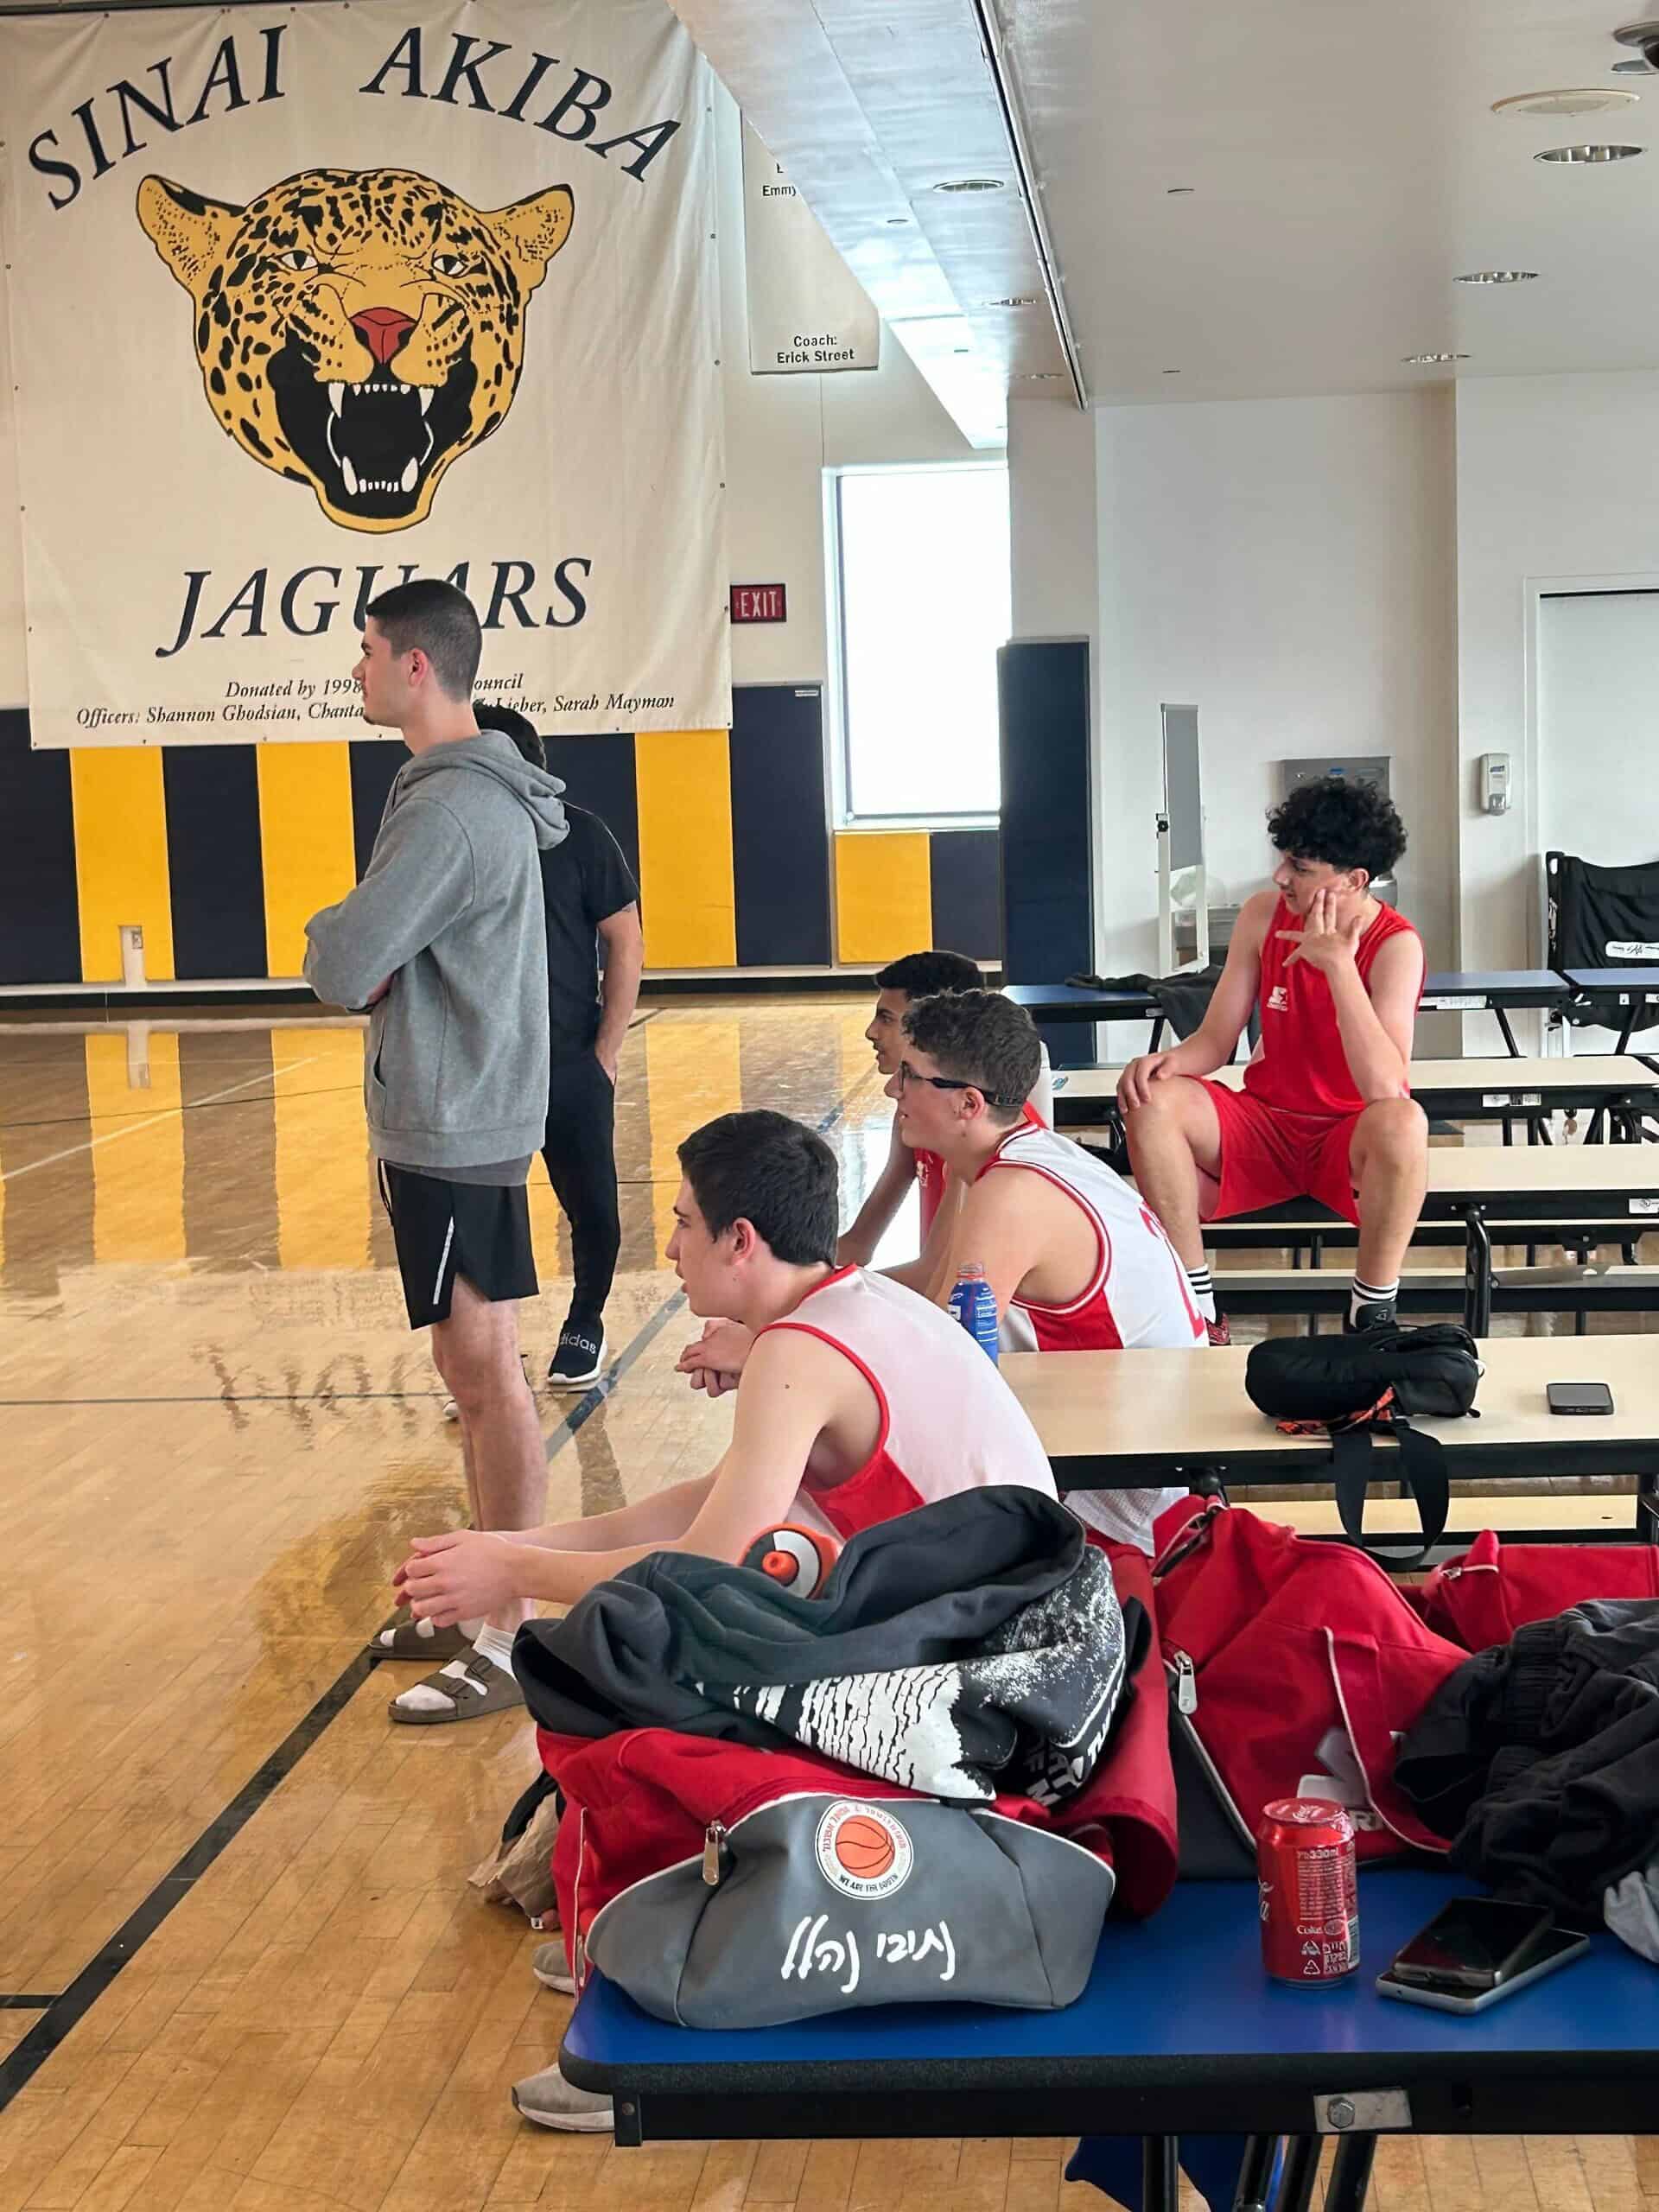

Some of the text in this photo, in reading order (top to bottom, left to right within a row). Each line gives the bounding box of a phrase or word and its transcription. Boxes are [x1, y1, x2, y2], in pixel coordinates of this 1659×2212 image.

[28, 24, 682, 211] SINAI AKIBA
[793, 334, 837, 347] Coach:
[777, 348, 855, 364] Erick Street
[741, 591, 777, 617] EXIT
[225, 672, 524, 700] Donated by 1998 ouncil
[76, 708, 140, 729] Officers:
[146, 705, 216, 724] Shannon
[222, 703, 301, 722] Ghodsian,
[308, 702, 364, 719] Chanta
[553, 694, 600, 713] Sarah
[605, 693, 675, 714] Mayman
